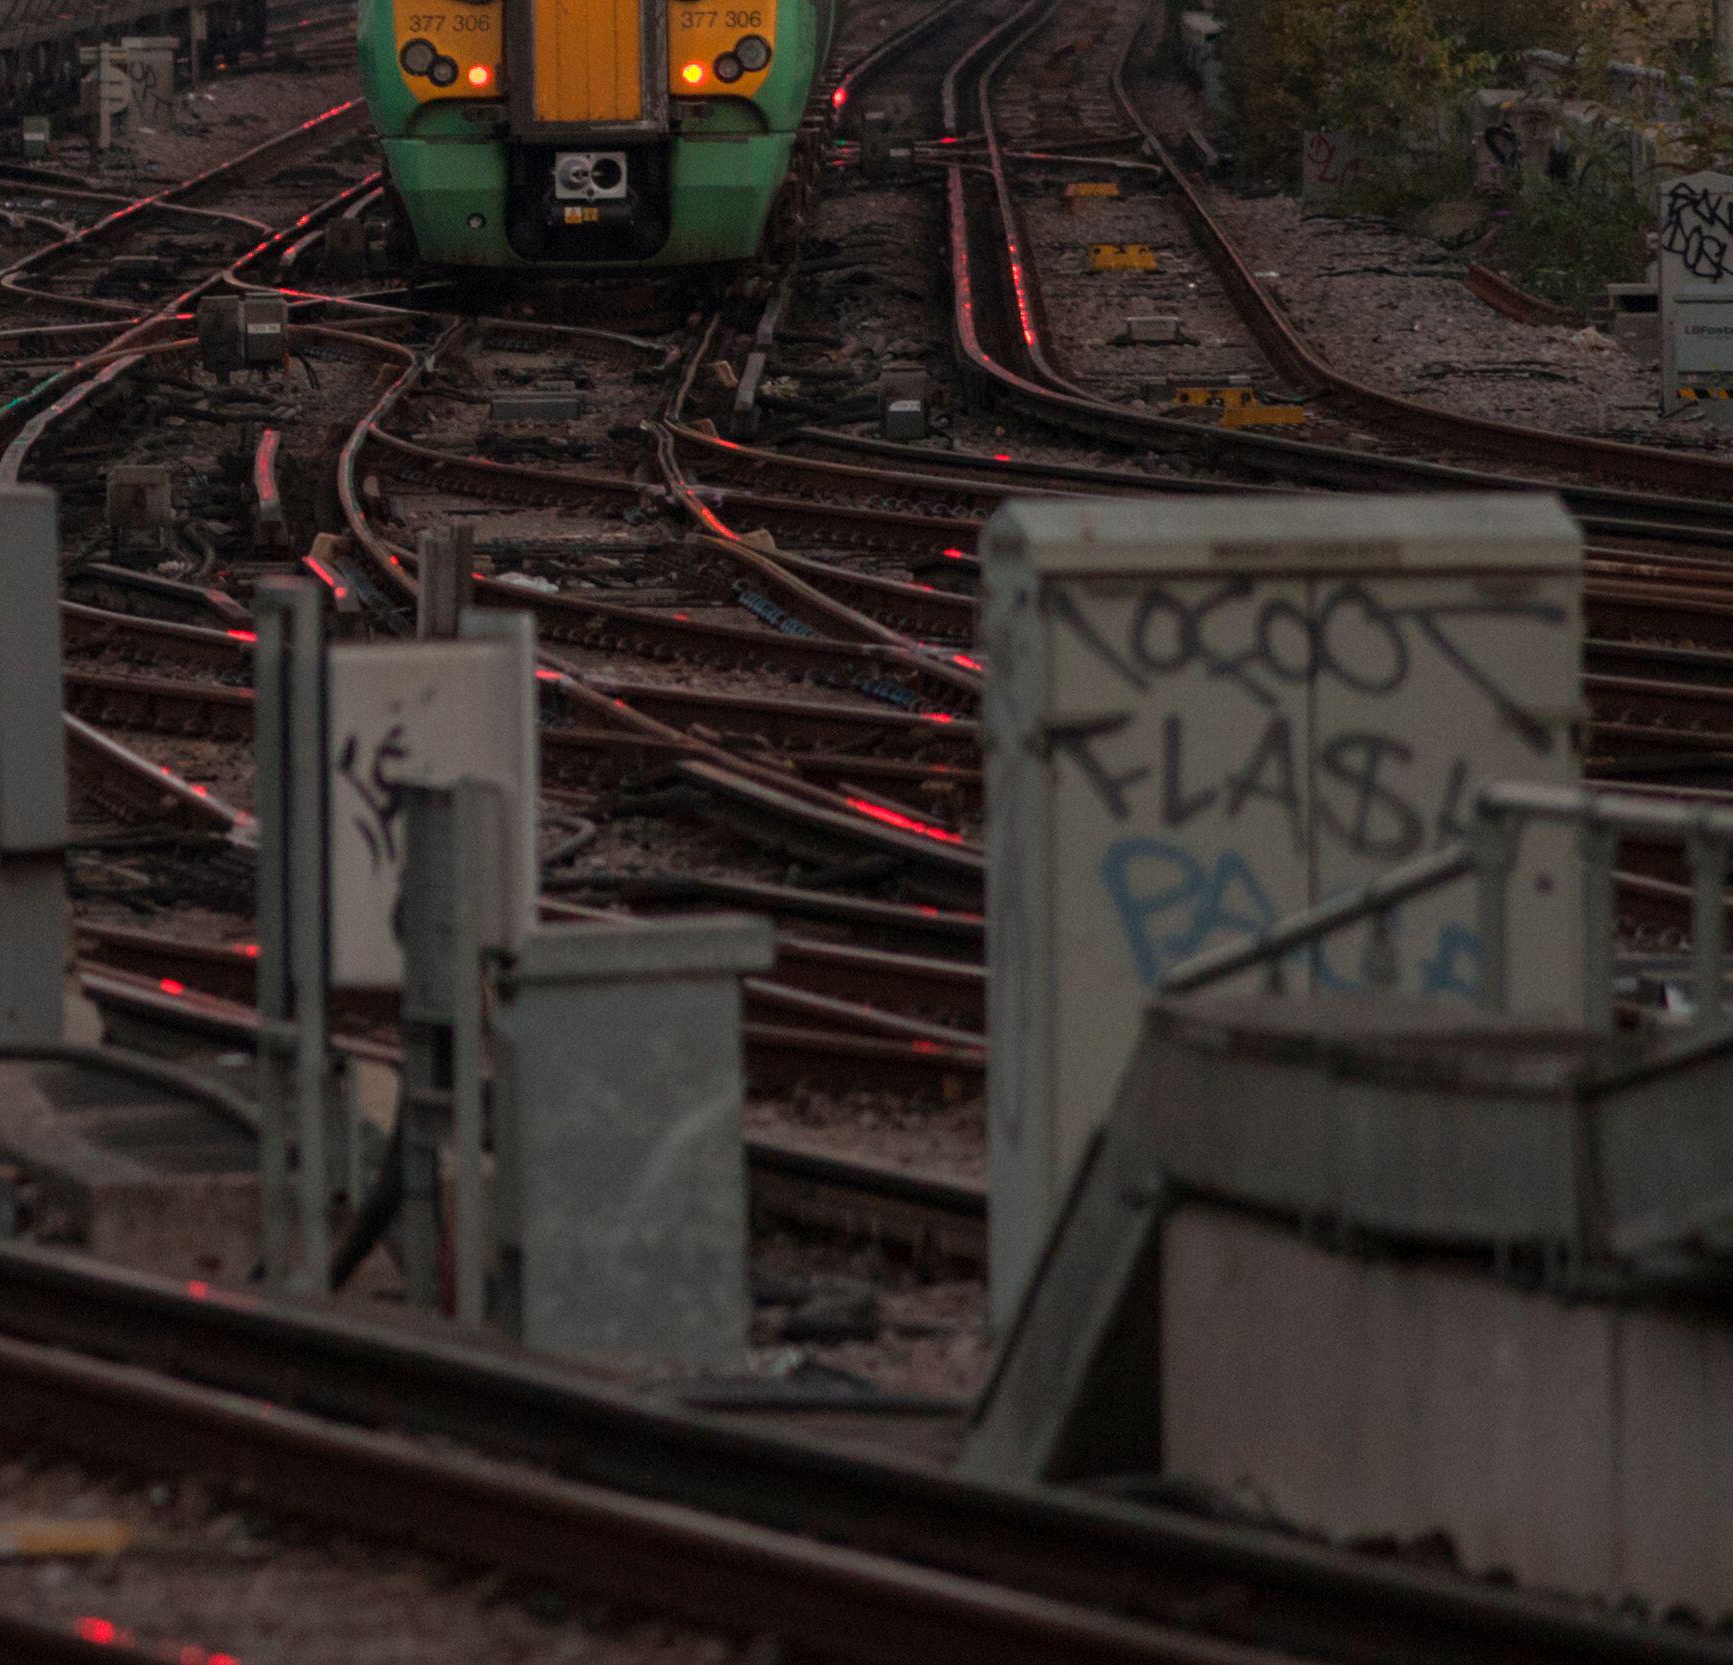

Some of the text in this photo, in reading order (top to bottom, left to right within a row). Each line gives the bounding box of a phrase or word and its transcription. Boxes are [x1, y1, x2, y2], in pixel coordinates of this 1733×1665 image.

[410, 14, 490, 32] 377 306
[681, 11, 761, 29] 377 306
